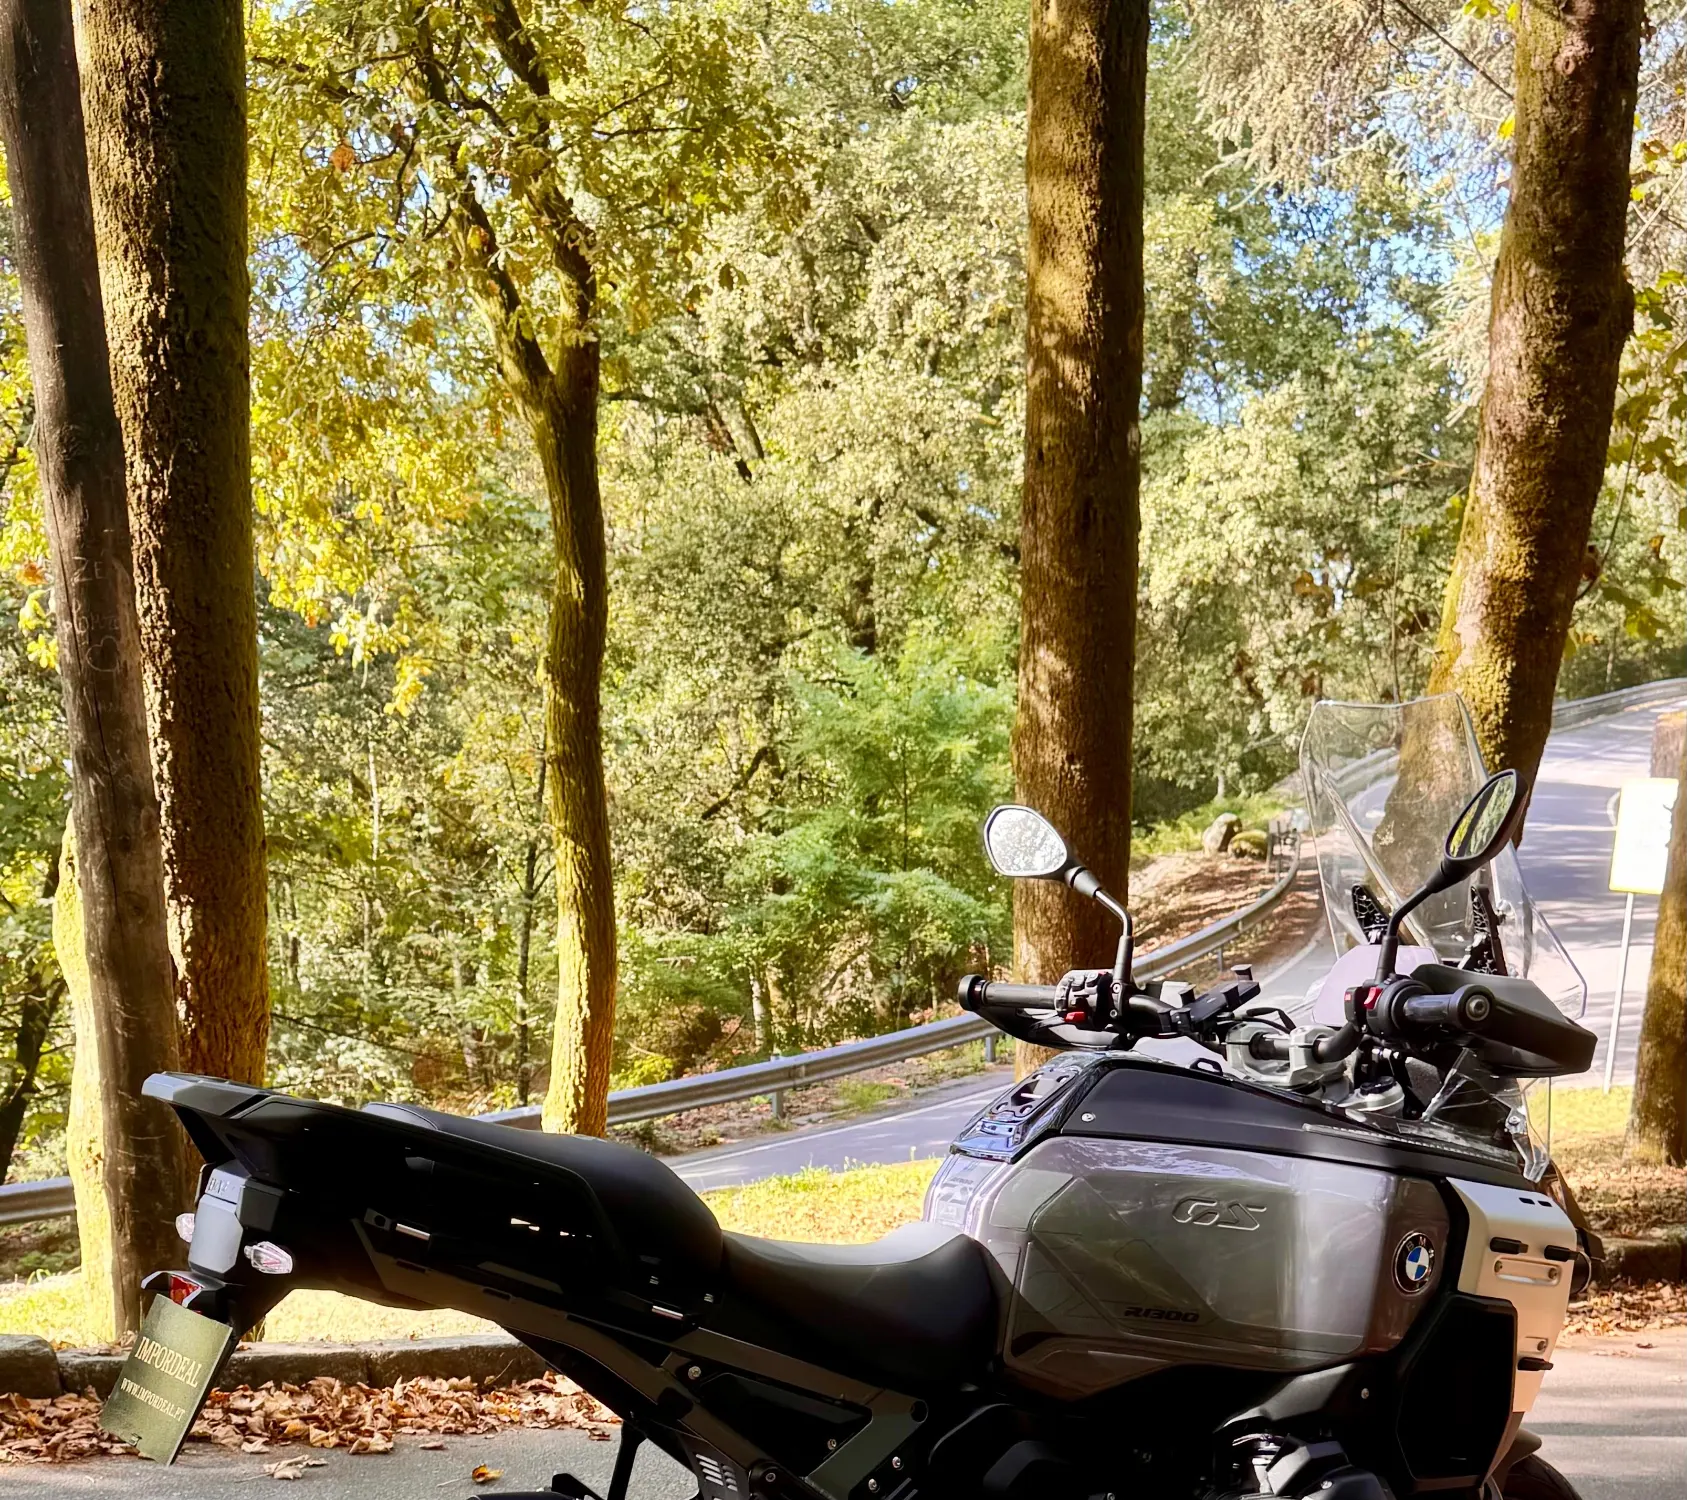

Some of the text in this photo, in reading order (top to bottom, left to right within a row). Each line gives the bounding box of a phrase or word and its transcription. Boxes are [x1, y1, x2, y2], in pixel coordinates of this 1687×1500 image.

[1172, 1196, 1267, 1231] GS
[1124, 1306, 1199, 1322] R1300
[134, 1336, 202, 1388] IMPORDEAL
[120, 1377, 186, 1421] WWW.IMPORDEAL.PT
